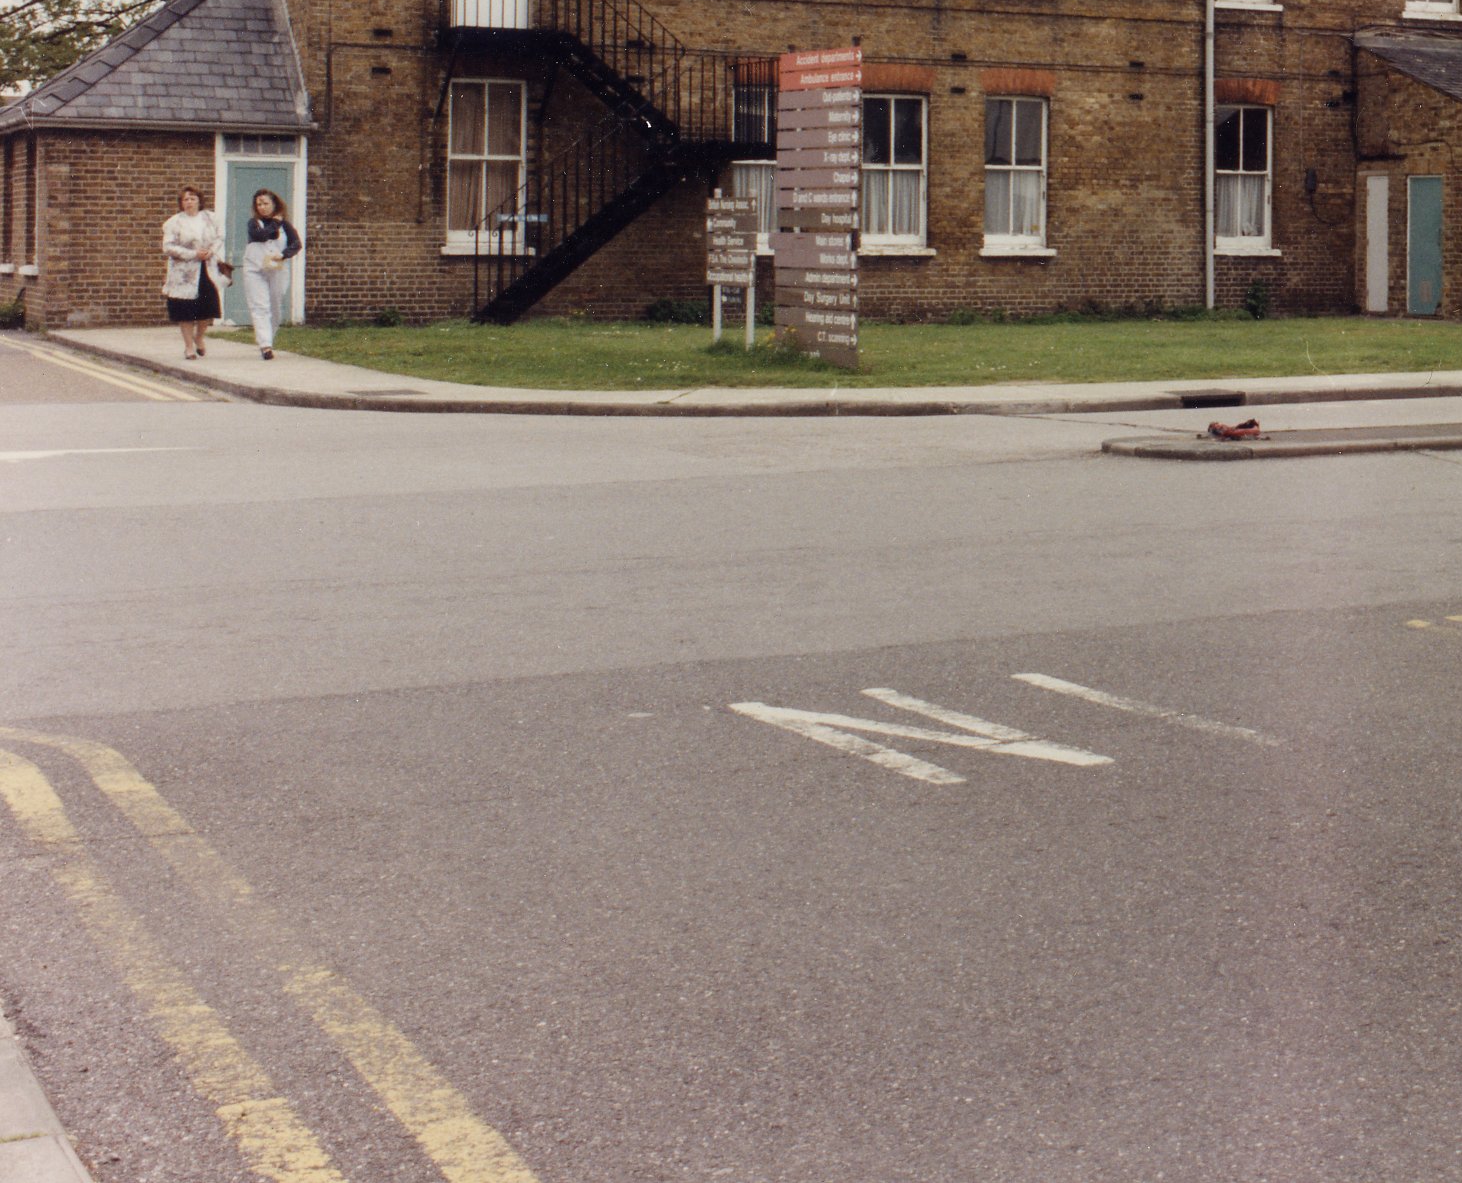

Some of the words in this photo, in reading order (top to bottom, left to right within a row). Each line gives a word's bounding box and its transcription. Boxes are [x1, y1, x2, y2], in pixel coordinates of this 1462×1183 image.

[796, 54, 819, 65] Accident
[801, 73, 829, 84] Ambulance
[831, 72, 854, 82] entrance
[828, 131, 837, 144] Eye
[838, 131, 851, 142] clinic
[823, 151, 838, 164] X-ray
[833, 171, 850, 184] Chapel
[798, 192, 808, 203] and
[829, 193, 850, 203] entrance
[821, 212, 831, 225] Day
[832, 213, 852, 226] hospital
[727, 235, 744, 246] Service
[819, 253, 835, 264] Works
[803, 290, 815, 305] Day
[816, 291, 838, 306] Surgery
[839, 293, 851, 305] Unit
[805, 311, 825, 326] Hearing
[825, 313, 834, 324] aid
[834, 314, 850, 326] centre
[828, 333, 850, 346] scanning
